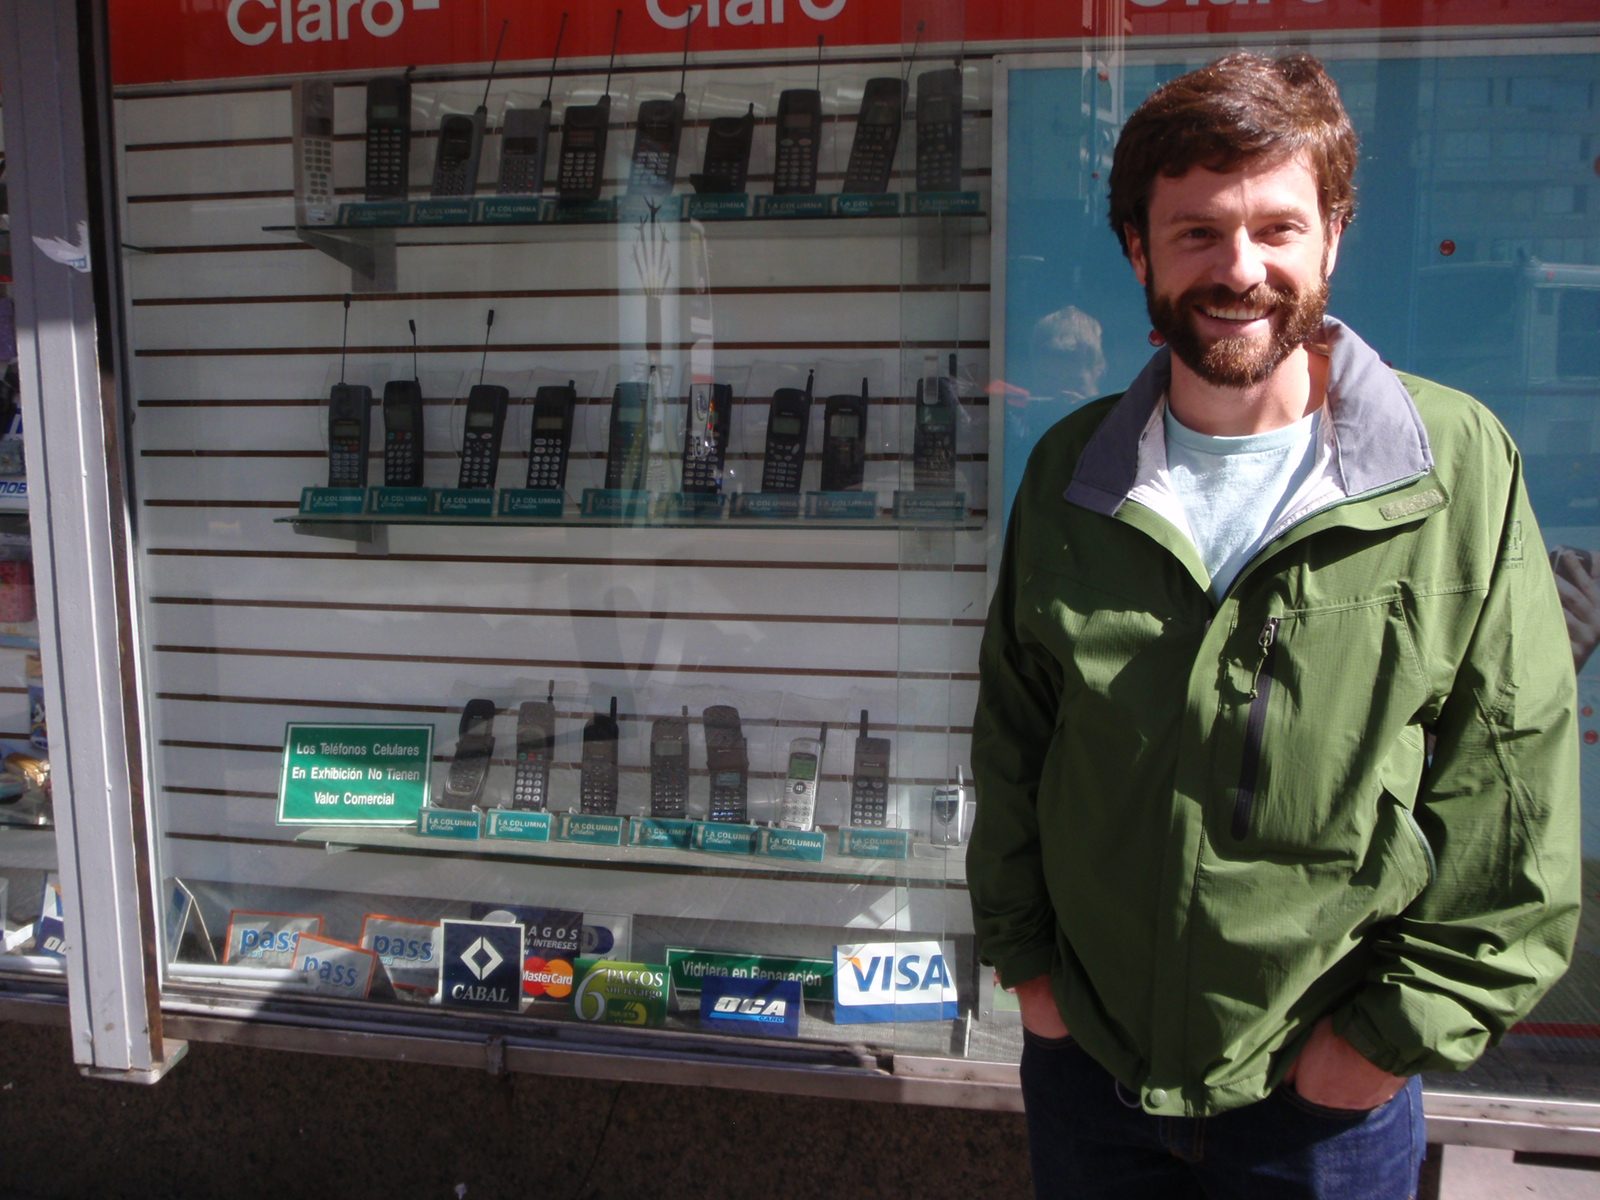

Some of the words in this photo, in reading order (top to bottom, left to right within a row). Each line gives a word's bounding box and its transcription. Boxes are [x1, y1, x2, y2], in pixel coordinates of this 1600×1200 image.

[227, 0, 405, 46] Claro
[453, 496, 492, 505] COLUMNA
[522, 496, 562, 505] COLUMNA
[296, 742, 316, 755] Los
[319, 741, 367, 756] Teléfonos
[372, 743, 420, 757] Celulares
[291, 766, 306, 780] En
[310, 766, 364, 781] Exhibición
[367, 767, 383, 781] No
[386, 767, 421, 781] Tienen
[313, 791, 340, 805] Valor
[343, 791, 395, 806] Comercial
[429, 817, 440, 826] LA
[440, 818, 478, 828] COLUMNA
[498, 818, 509, 826] LA
[509, 819, 548, 829] COLUMNA
[581, 823, 620, 833] COLUMNA
[769, 836, 780, 845] LA
[781, 838, 822, 849] COLUMNA
[373, 934, 434, 963] pass
[532, 939, 579, 951] INTERESES
[522, 969, 574, 986] MasterCard
[681, 960, 729, 977] Vidriera
[731, 967, 748, 978] en
[751, 965, 823, 987] Reparación
[847, 954, 951, 993] VISA
[451, 983, 511, 1003] CABAL
[574, 968, 607, 1021] 6
[606, 968, 664, 988] PAGOS
[713, 996, 786, 1017] OCA
